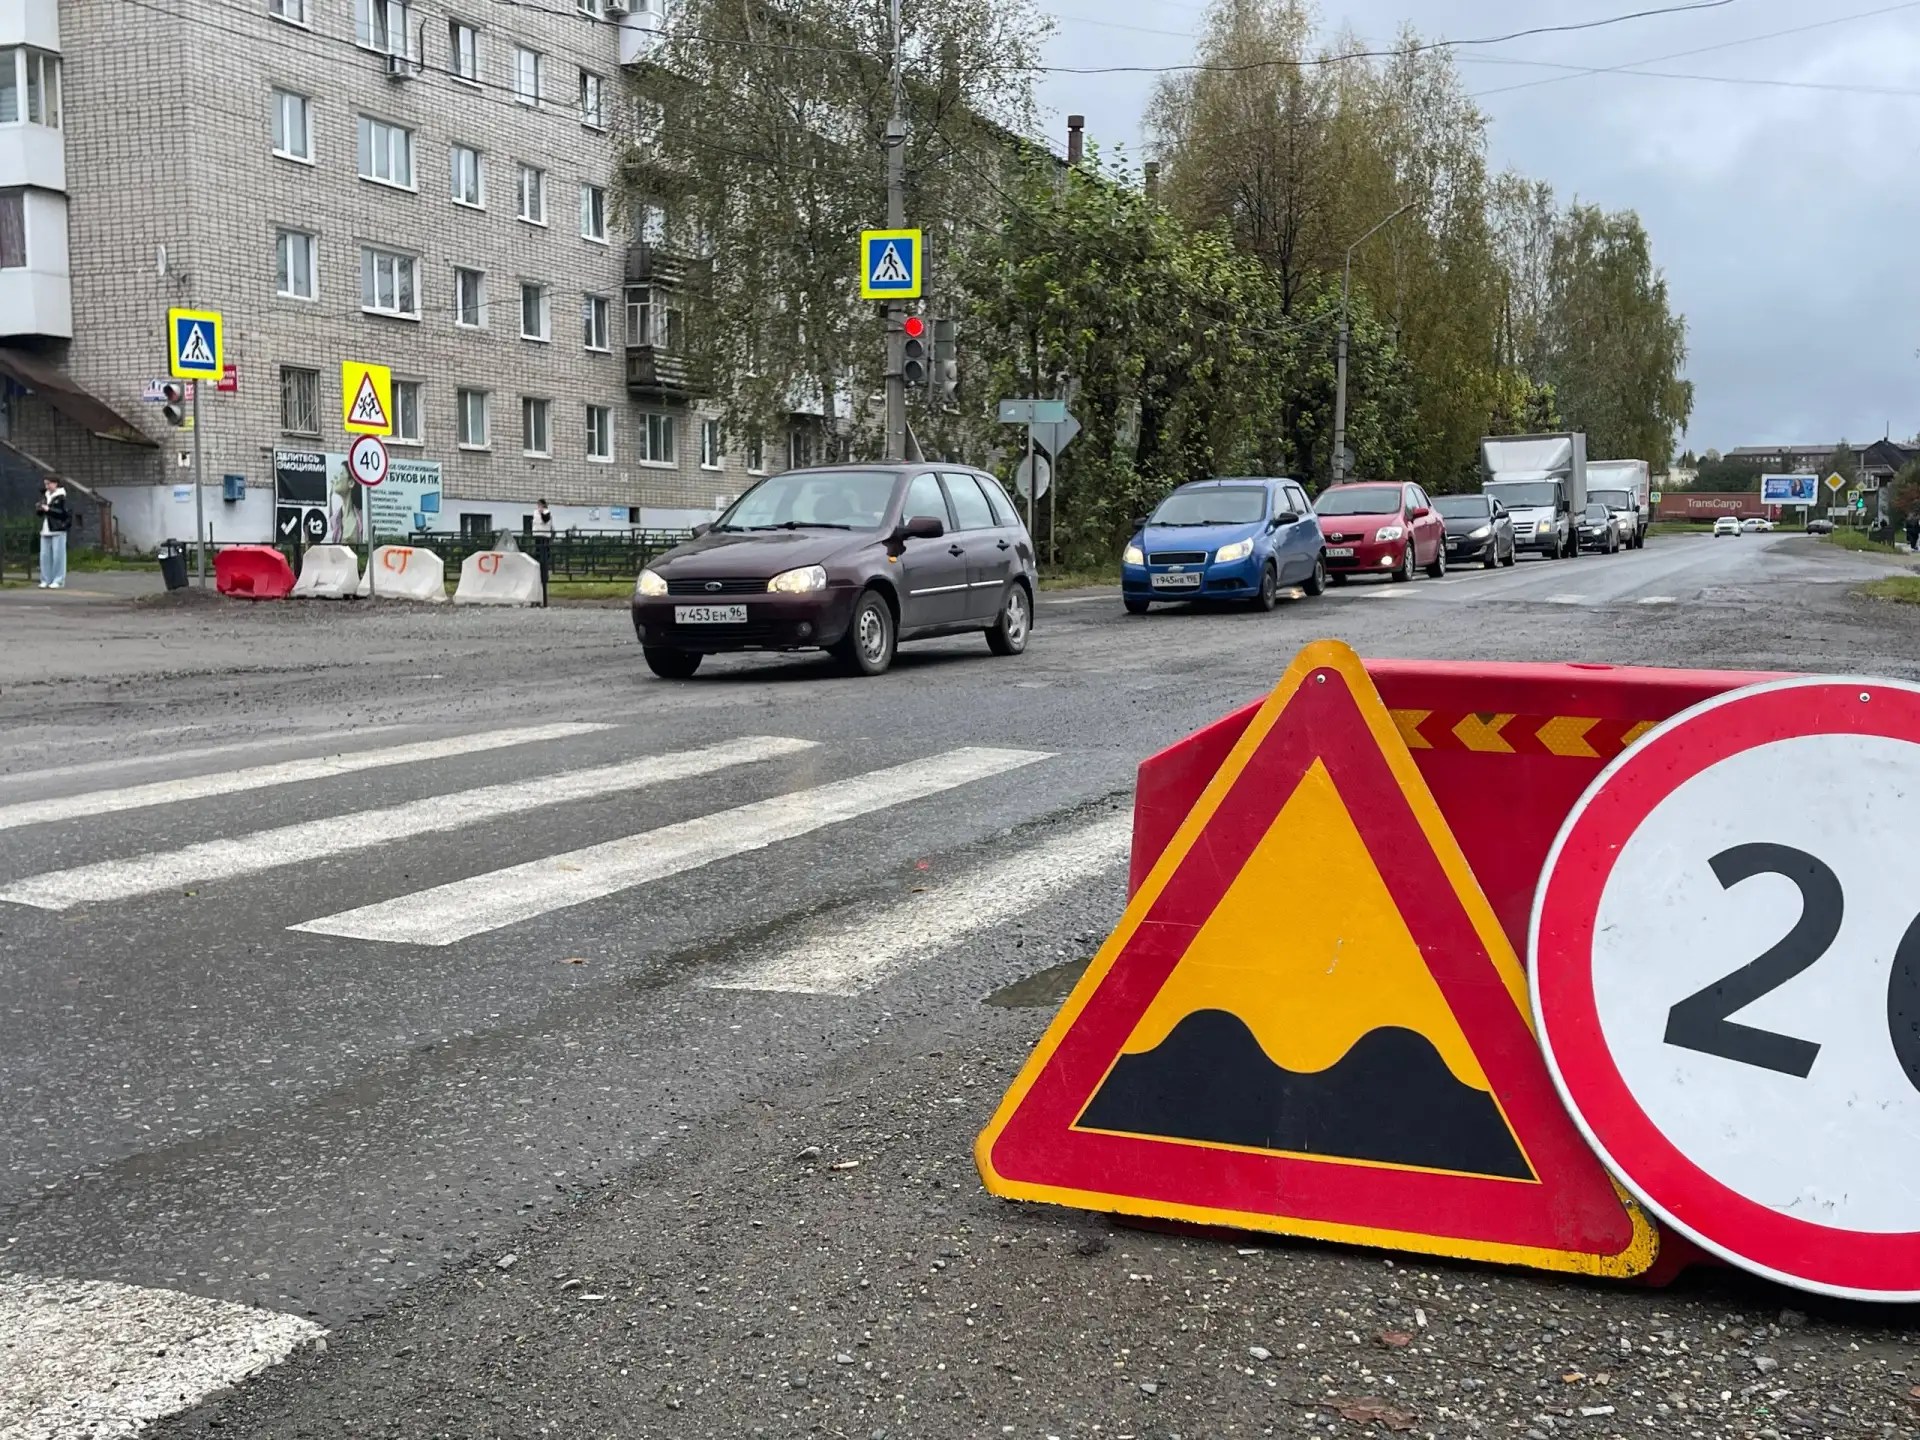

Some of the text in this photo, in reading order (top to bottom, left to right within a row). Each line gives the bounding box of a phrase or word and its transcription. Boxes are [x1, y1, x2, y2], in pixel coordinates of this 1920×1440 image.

[277, 452, 320, 463] ДЕЛИТЕСЬ
[360, 451, 380, 471] 40
[277, 461, 325, 473] ЭМОЦИЯМИ
[419, 473, 426, 484] И
[427, 474, 439, 485] ПК
[1687, 498, 1743, 510] TransCargo
[308, 517, 323, 535] t2
[384, 549, 412, 575] СТ
[478, 554, 503, 575] СТ
[729, 606, 742, 617] 96
[1663, 842, 1920, 1093] 2
